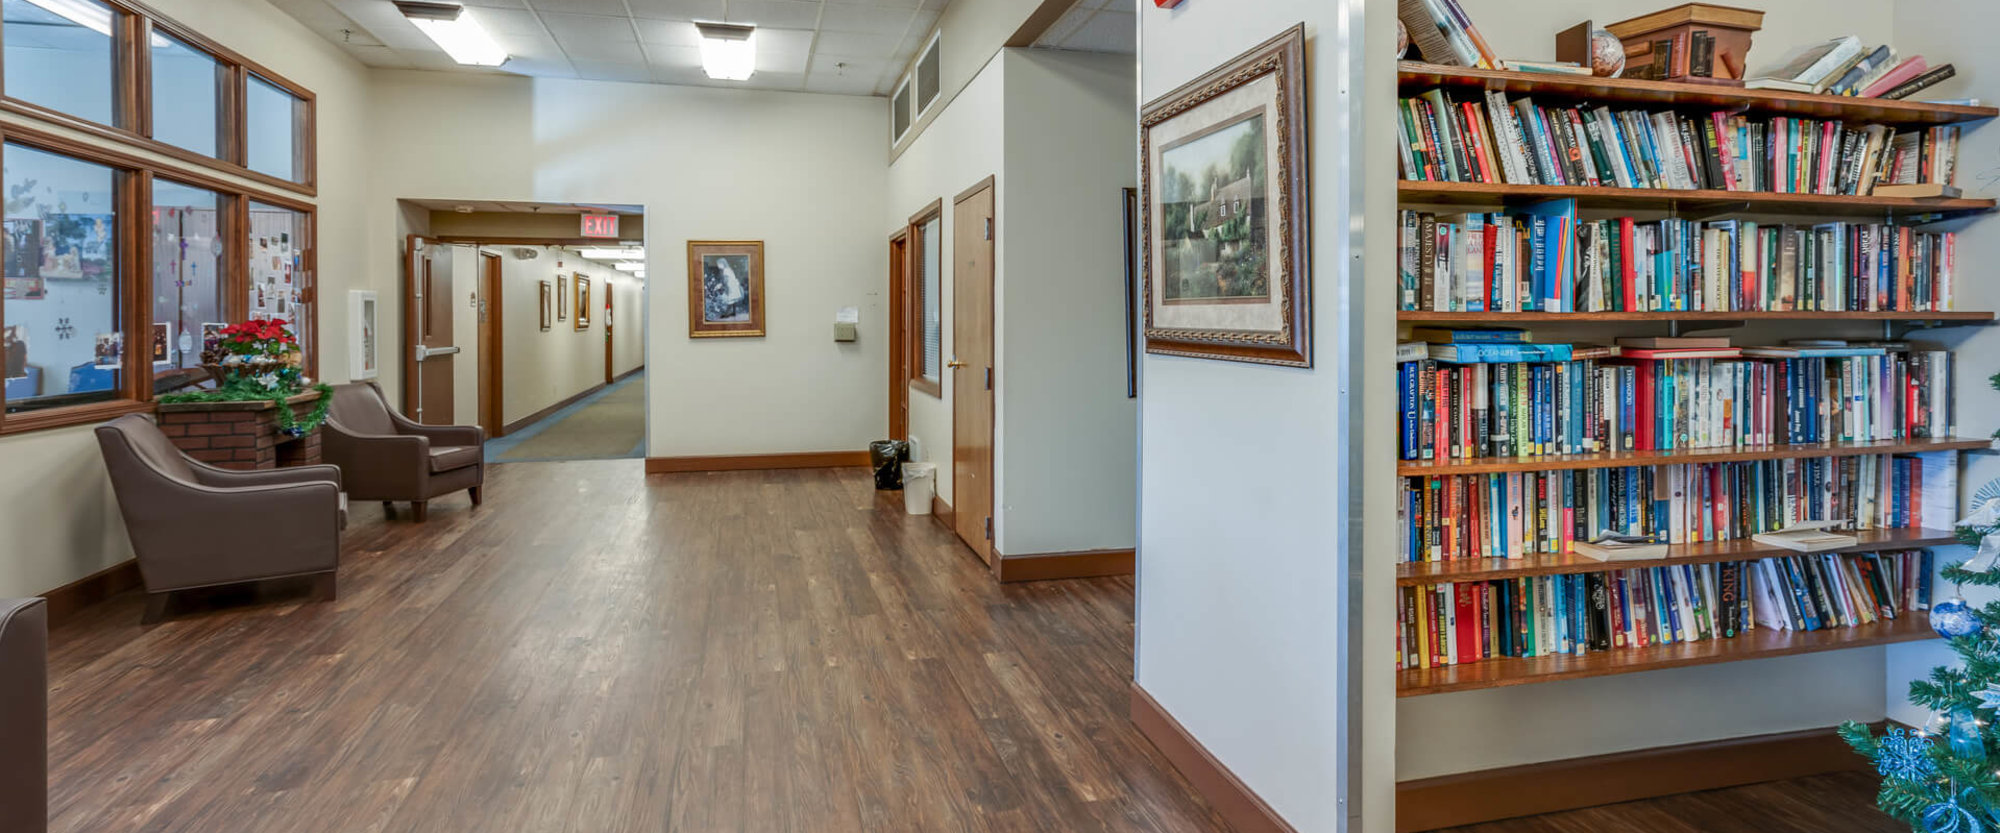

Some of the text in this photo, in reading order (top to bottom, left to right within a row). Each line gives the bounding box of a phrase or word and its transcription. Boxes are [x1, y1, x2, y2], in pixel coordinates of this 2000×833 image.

[584, 216, 617, 234] EXIT
[1424, 223, 1434, 265] MAJESTY
[1722, 569, 1735, 602] KING
